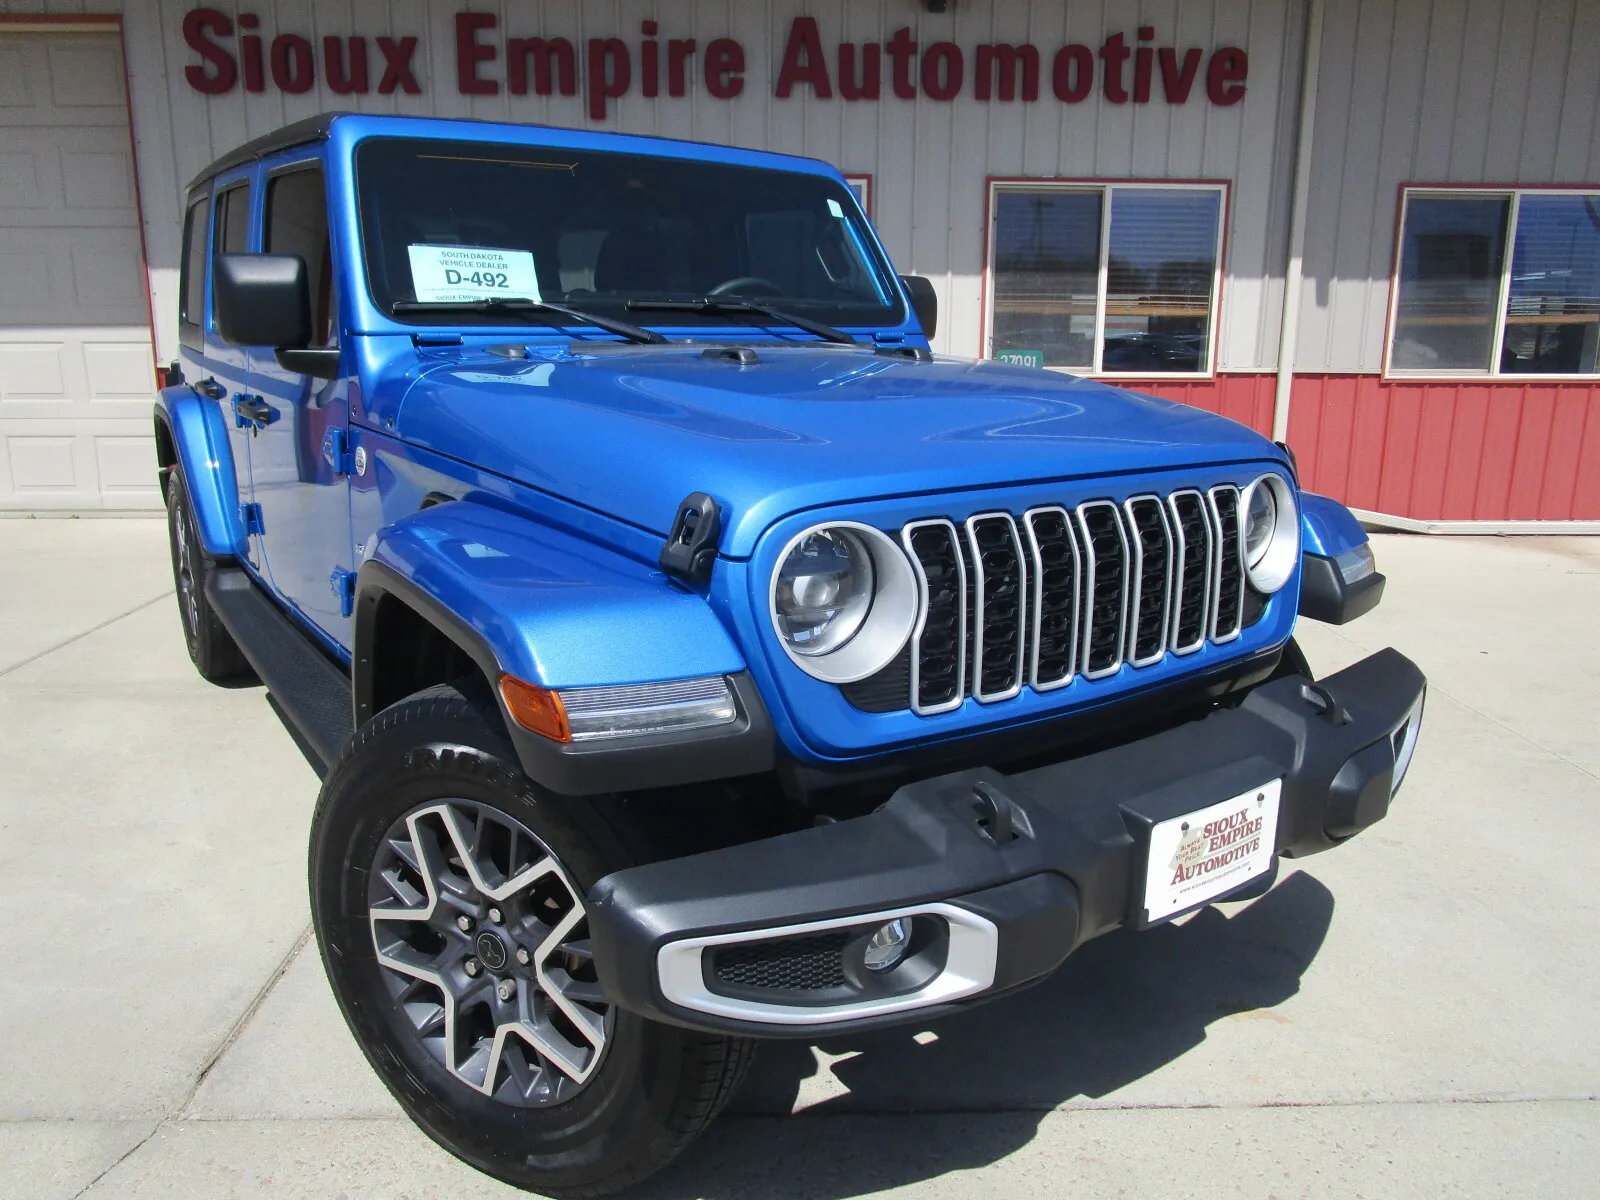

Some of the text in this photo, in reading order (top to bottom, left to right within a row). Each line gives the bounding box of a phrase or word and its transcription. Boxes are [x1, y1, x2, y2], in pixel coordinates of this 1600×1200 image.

[183, 8, 1249, 120] Sioux Empire Automotive
[439, 260, 508, 270] VEHICLE DEALER
[441, 251, 504, 261] SOUTH DAKOTA
[445, 269, 509, 288] D-492
[1203, 808, 1249, 839] SIOUX
[1208, 816, 1263, 853] EMPIRE
[1170, 837, 1260, 886] AUTOMOTIVE
